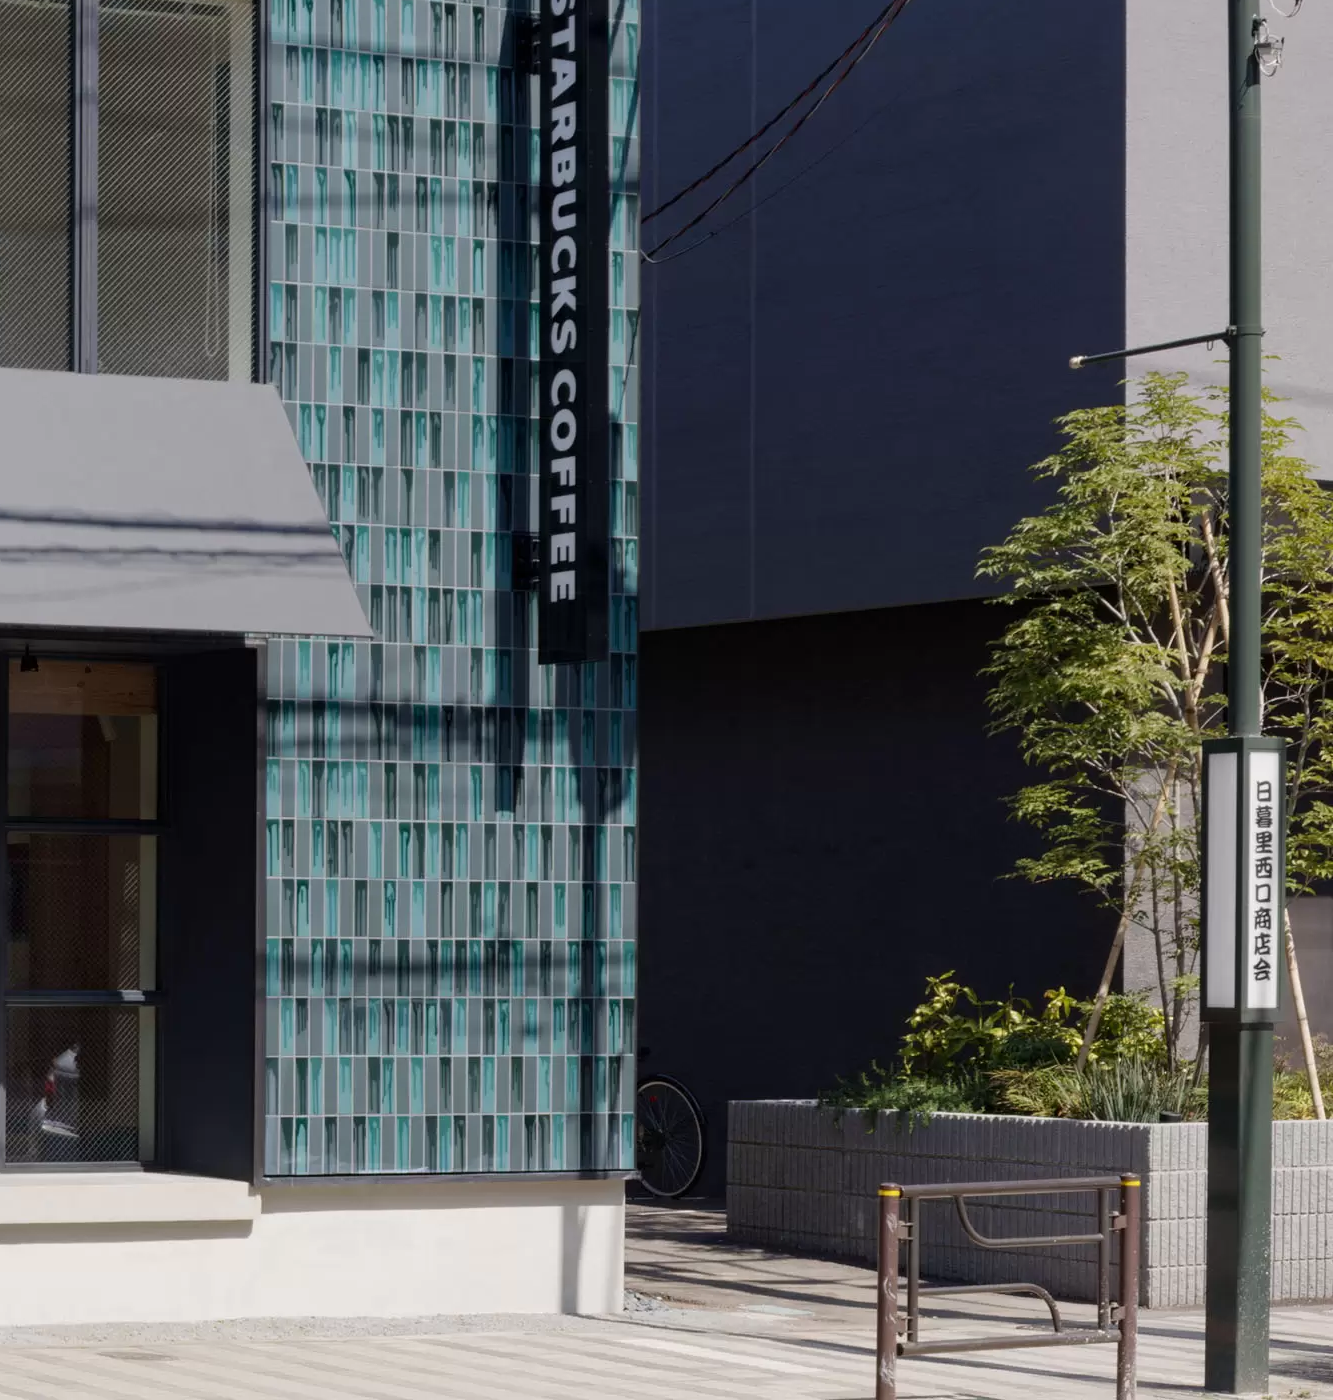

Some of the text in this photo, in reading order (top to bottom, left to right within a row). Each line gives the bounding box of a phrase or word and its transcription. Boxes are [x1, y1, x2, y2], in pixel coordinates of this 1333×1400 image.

[550, 368, 577, 604] COFFEE
[1253, 780, 1273, 982] 日暮里西口商店会
